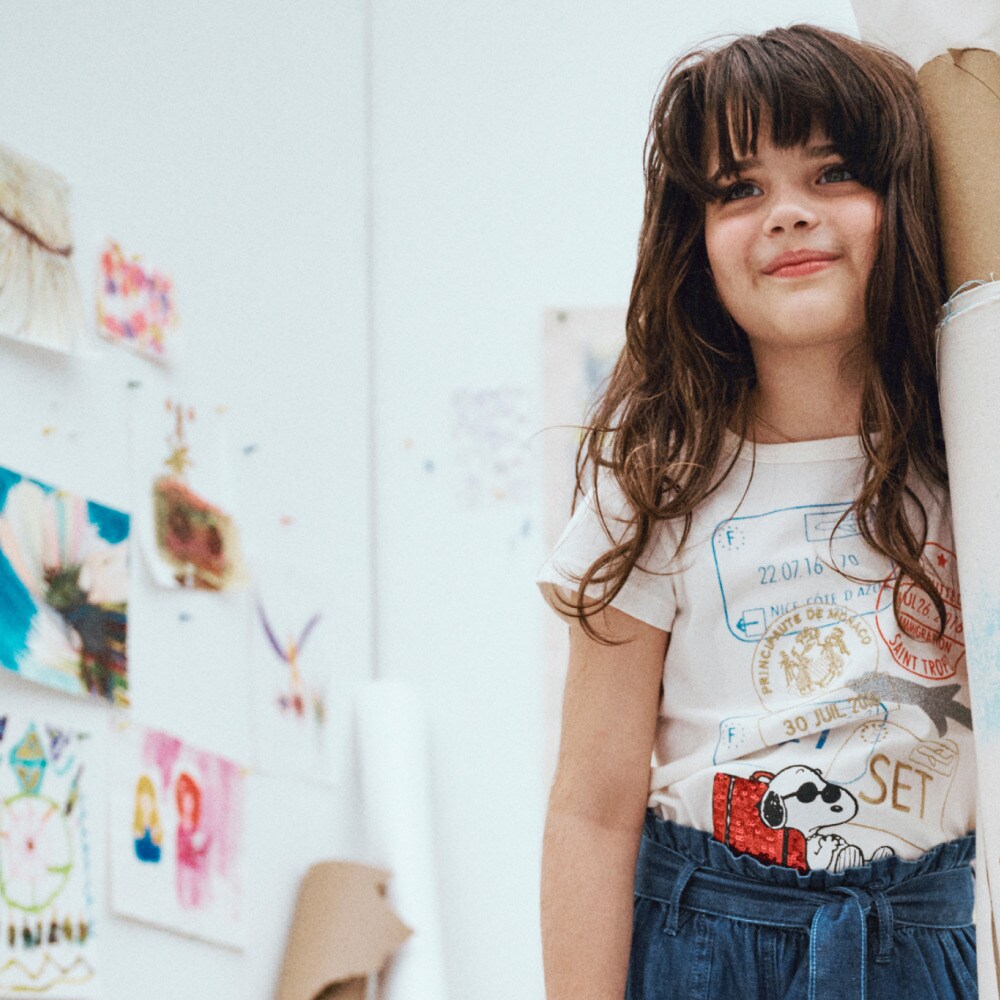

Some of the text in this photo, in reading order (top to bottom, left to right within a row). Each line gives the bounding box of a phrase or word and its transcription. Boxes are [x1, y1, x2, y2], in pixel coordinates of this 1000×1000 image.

[726, 530, 734, 545] F
[806, 608, 824, 620] DE
[828, 609, 872, 645] MONACO
[888, 633, 918, 670] SAINT
[728, 727, 736, 743] F
[783, 716, 808, 736] 30
[814, 703, 847, 727] JUIL
[858, 754, 934, 819] SET
